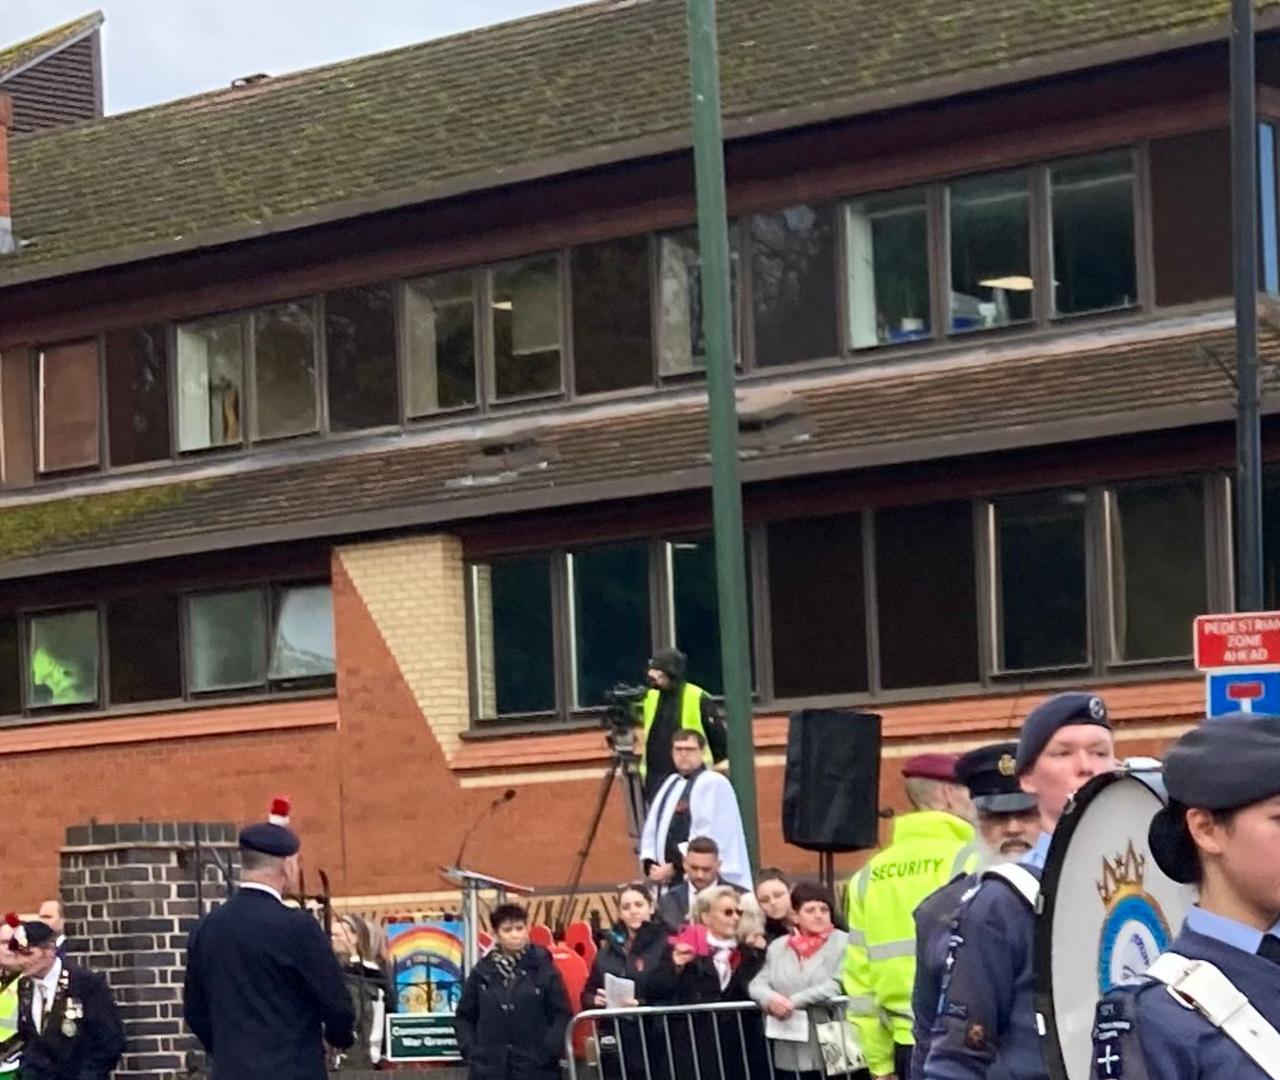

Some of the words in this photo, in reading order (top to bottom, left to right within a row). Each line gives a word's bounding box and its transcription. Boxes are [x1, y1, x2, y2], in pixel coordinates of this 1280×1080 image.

[1227, 634, 1263, 647] ZONE
[1223, 648, 1268, 662] AHEAD
[871, 858, 945, 882] SECURITY
[402, 1037, 422, 1047] War
